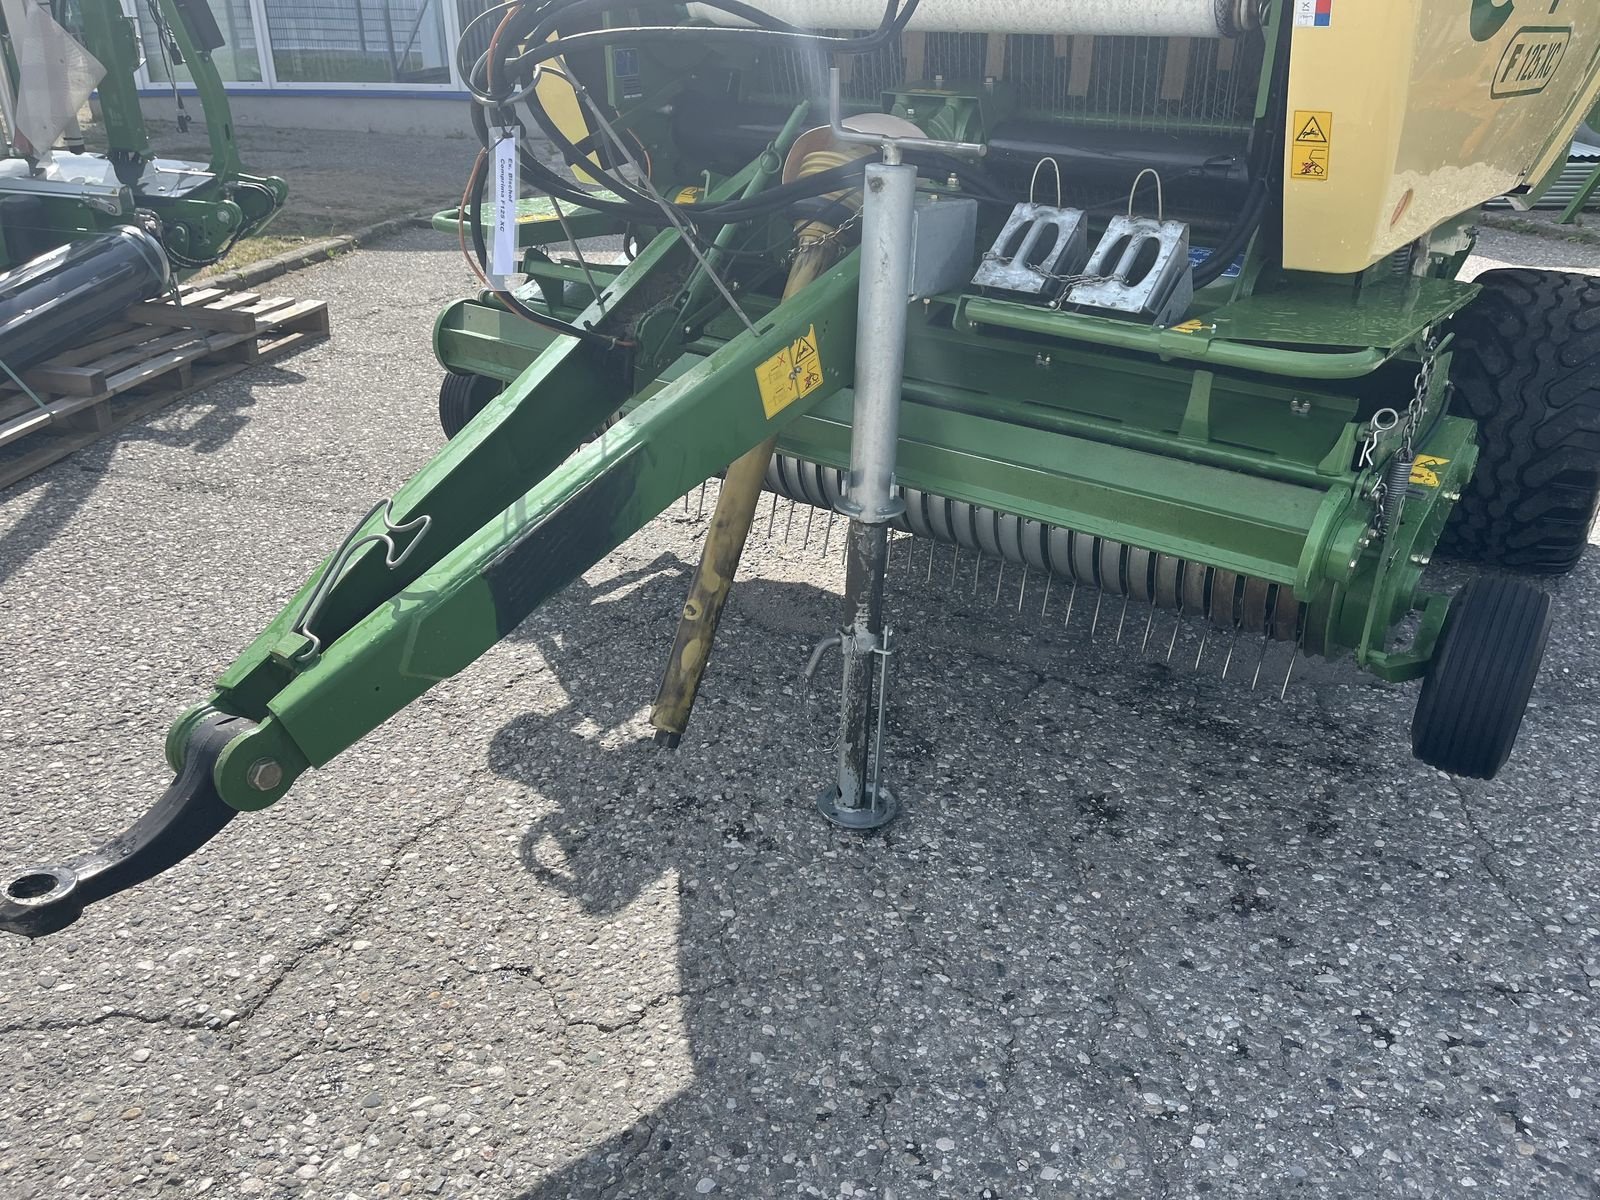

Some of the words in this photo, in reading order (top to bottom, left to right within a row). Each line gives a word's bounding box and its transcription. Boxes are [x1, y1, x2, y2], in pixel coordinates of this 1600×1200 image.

[1500, 44, 1525, 83] F
[1515, 44, 1548, 81] 125
[1534, 42, 1562, 79] XC
[499, 221, 505, 232] XC
